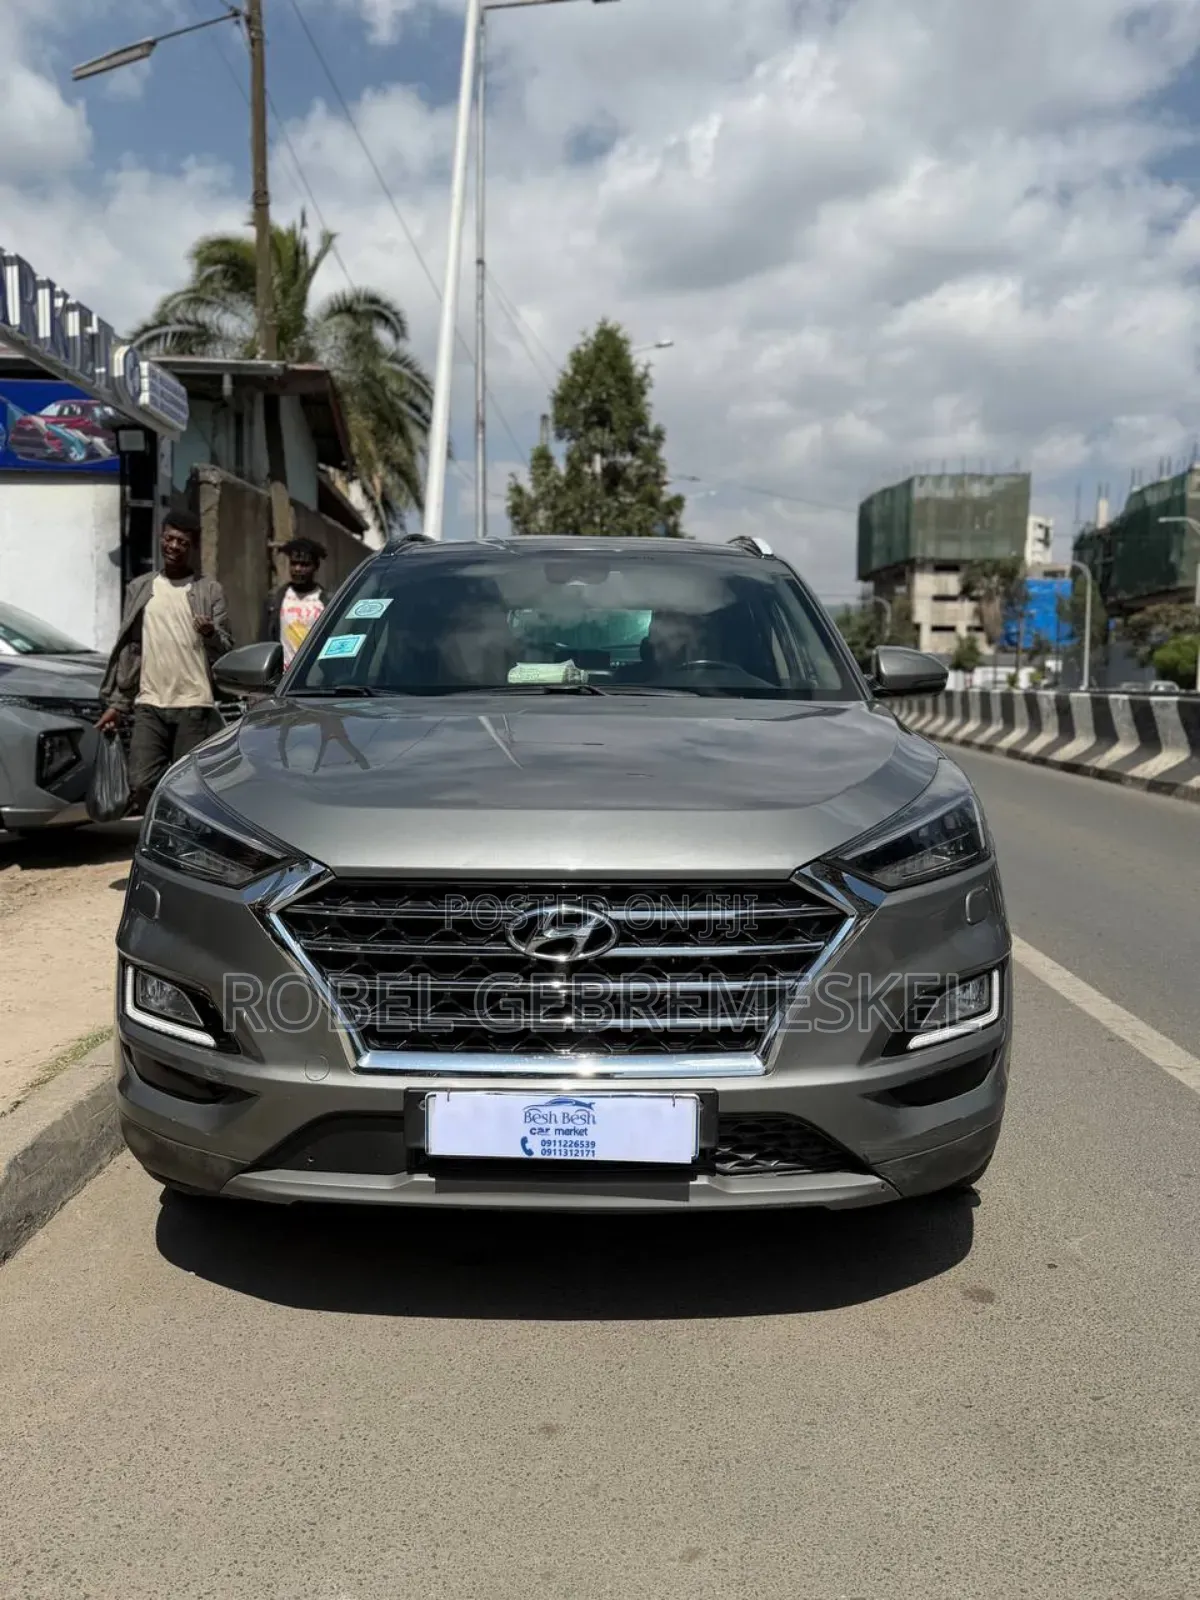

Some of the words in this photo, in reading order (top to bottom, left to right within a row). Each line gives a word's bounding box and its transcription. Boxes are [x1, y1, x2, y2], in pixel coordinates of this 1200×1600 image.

[523, 1108, 558, 1125] Besh
[561, 1108, 597, 1125] Besh
[529, 1127, 551, 1136] car
[554, 1126, 588, 1136] market
[540, 1139, 596, 1148] 0911226539
[540, 1148, 595, 1157] 0911312171
